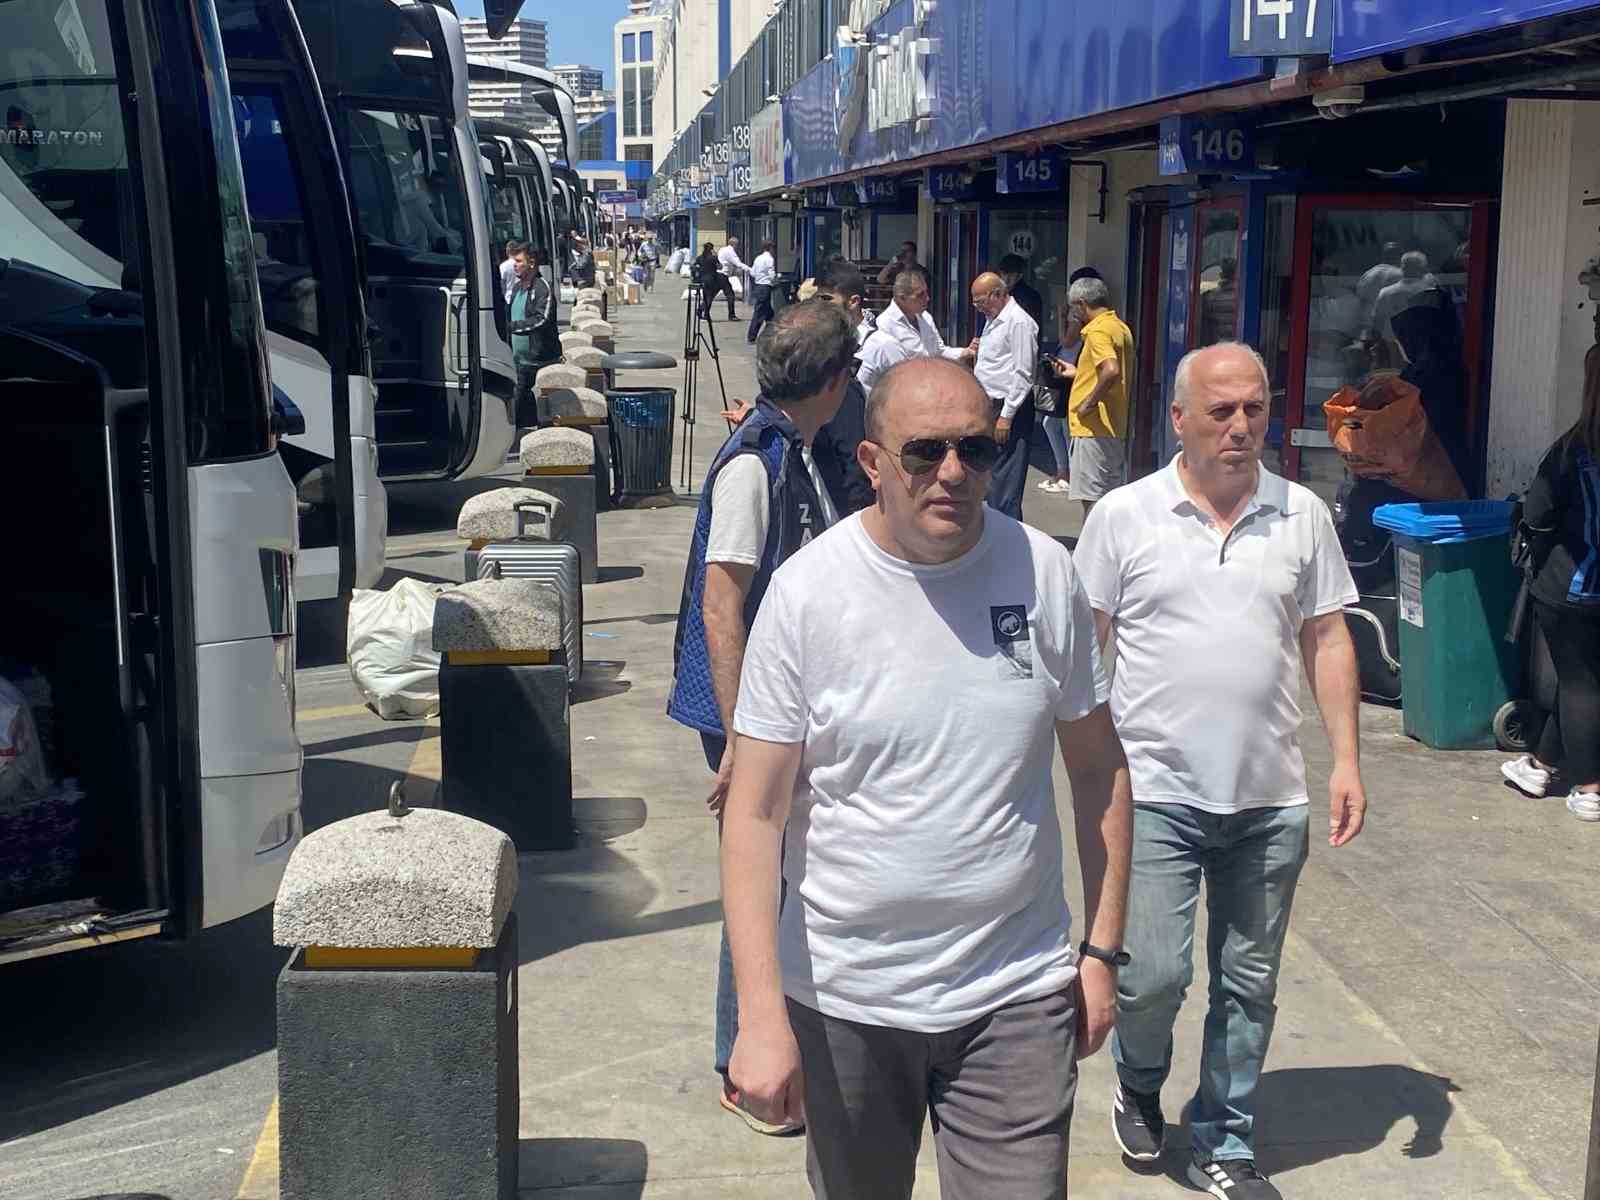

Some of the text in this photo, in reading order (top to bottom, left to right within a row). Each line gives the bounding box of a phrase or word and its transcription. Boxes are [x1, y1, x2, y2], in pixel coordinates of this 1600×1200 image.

[0, 129, 104, 145] MARATON
[733, 125, 751, 149] 138
[1191, 128, 1244, 160] 146
[714, 142, 728, 162] 136
[734, 166, 751, 190] 139
[1015, 159, 1051, 181] 145
[869, 180, 895, 196] 143
